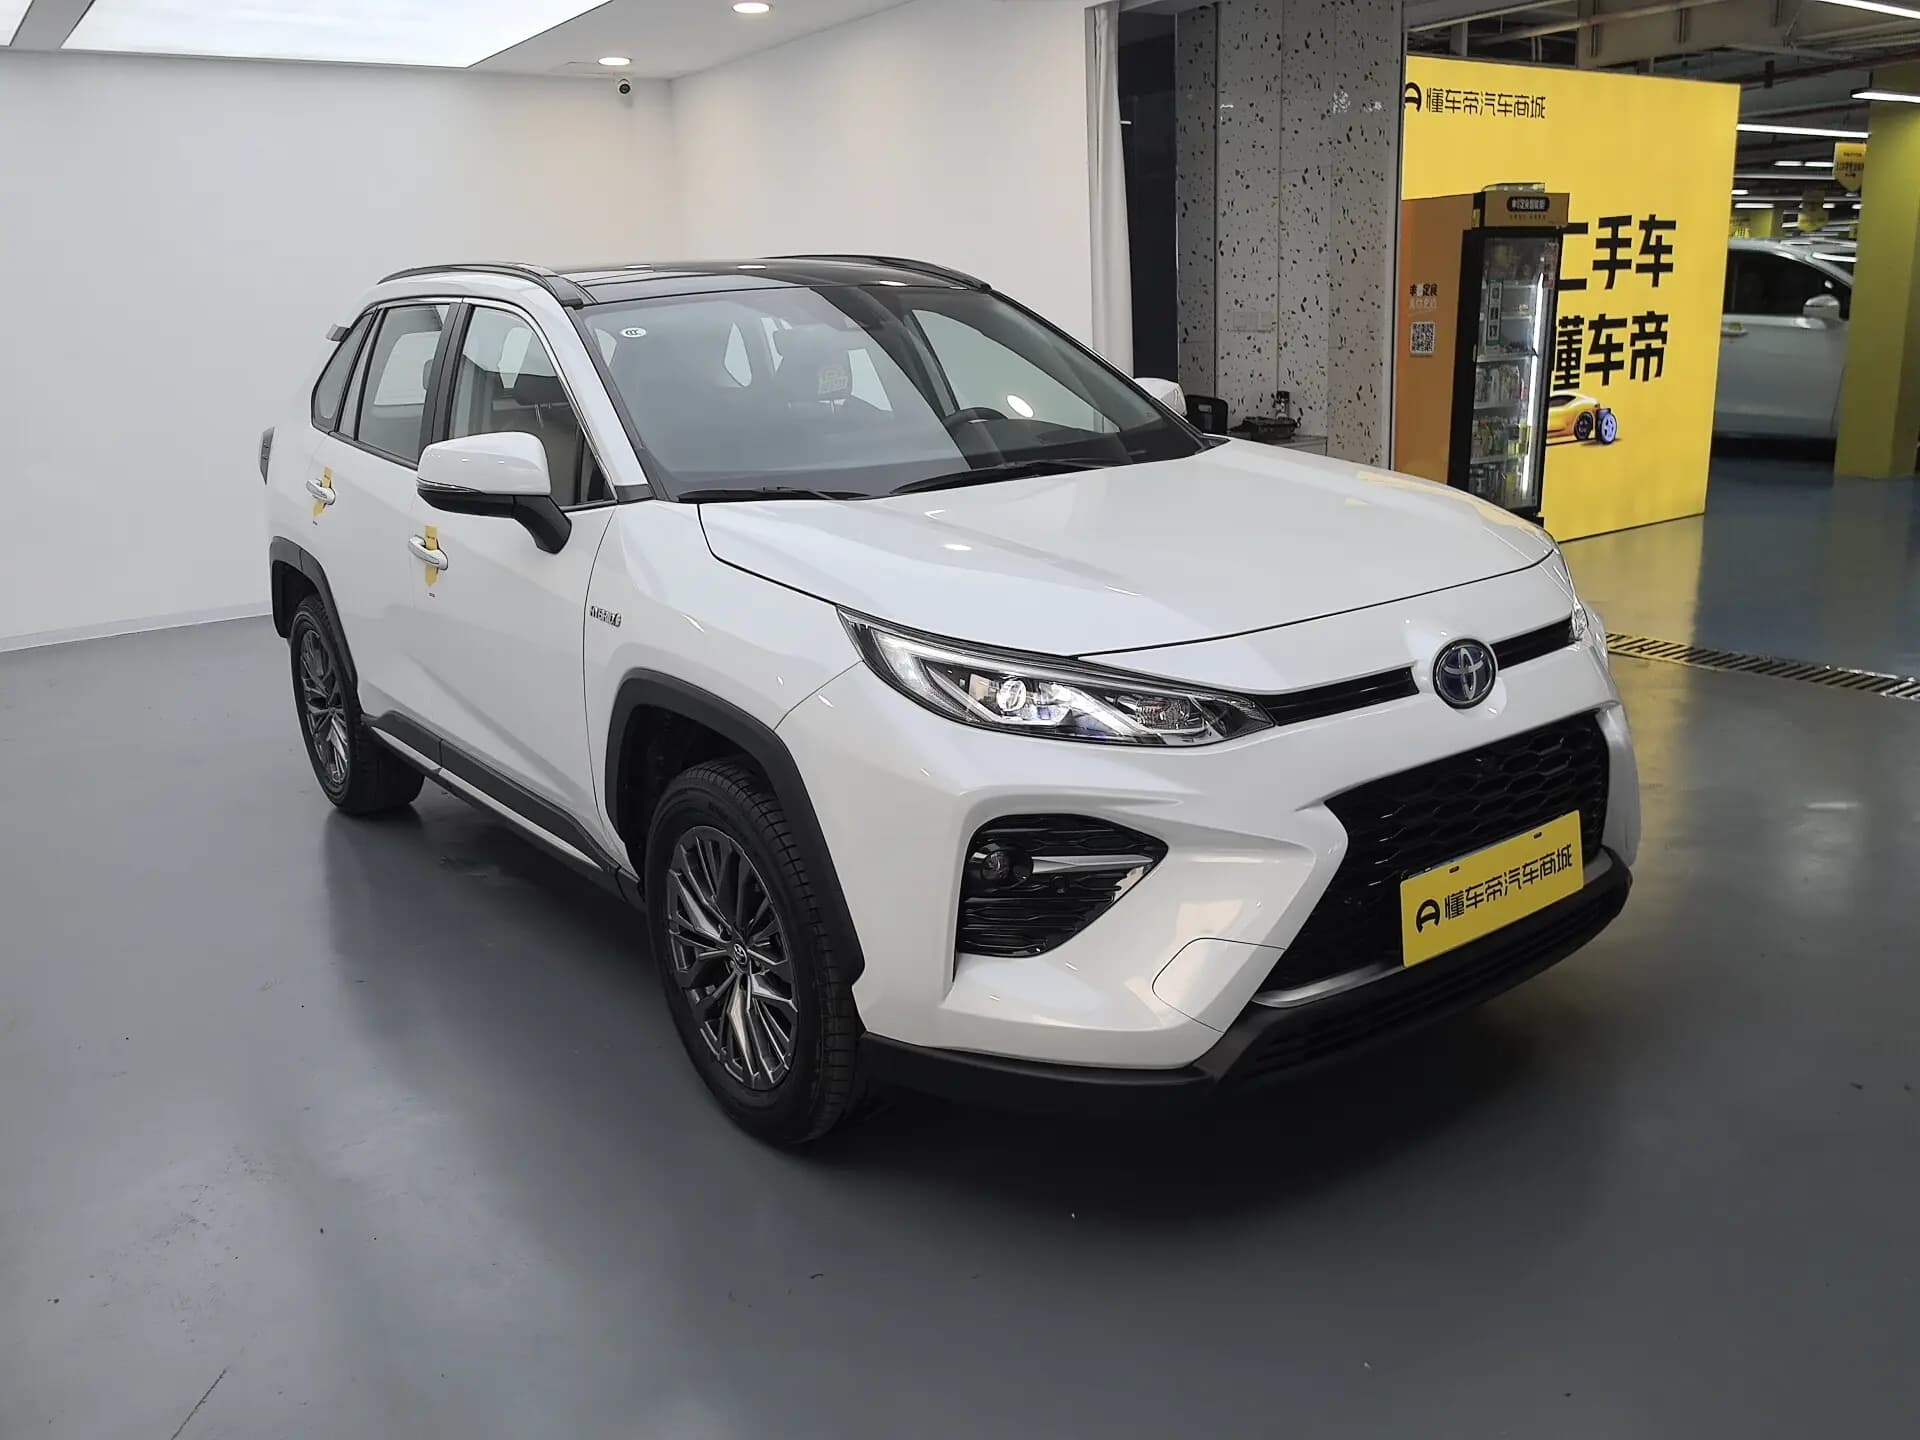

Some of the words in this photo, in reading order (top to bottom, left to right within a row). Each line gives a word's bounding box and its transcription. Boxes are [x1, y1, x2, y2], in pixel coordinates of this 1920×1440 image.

[1426, 87, 1546, 119] 懂车帝汽车商城
[1444, 843, 1573, 920] 懂车帝汽车商城
